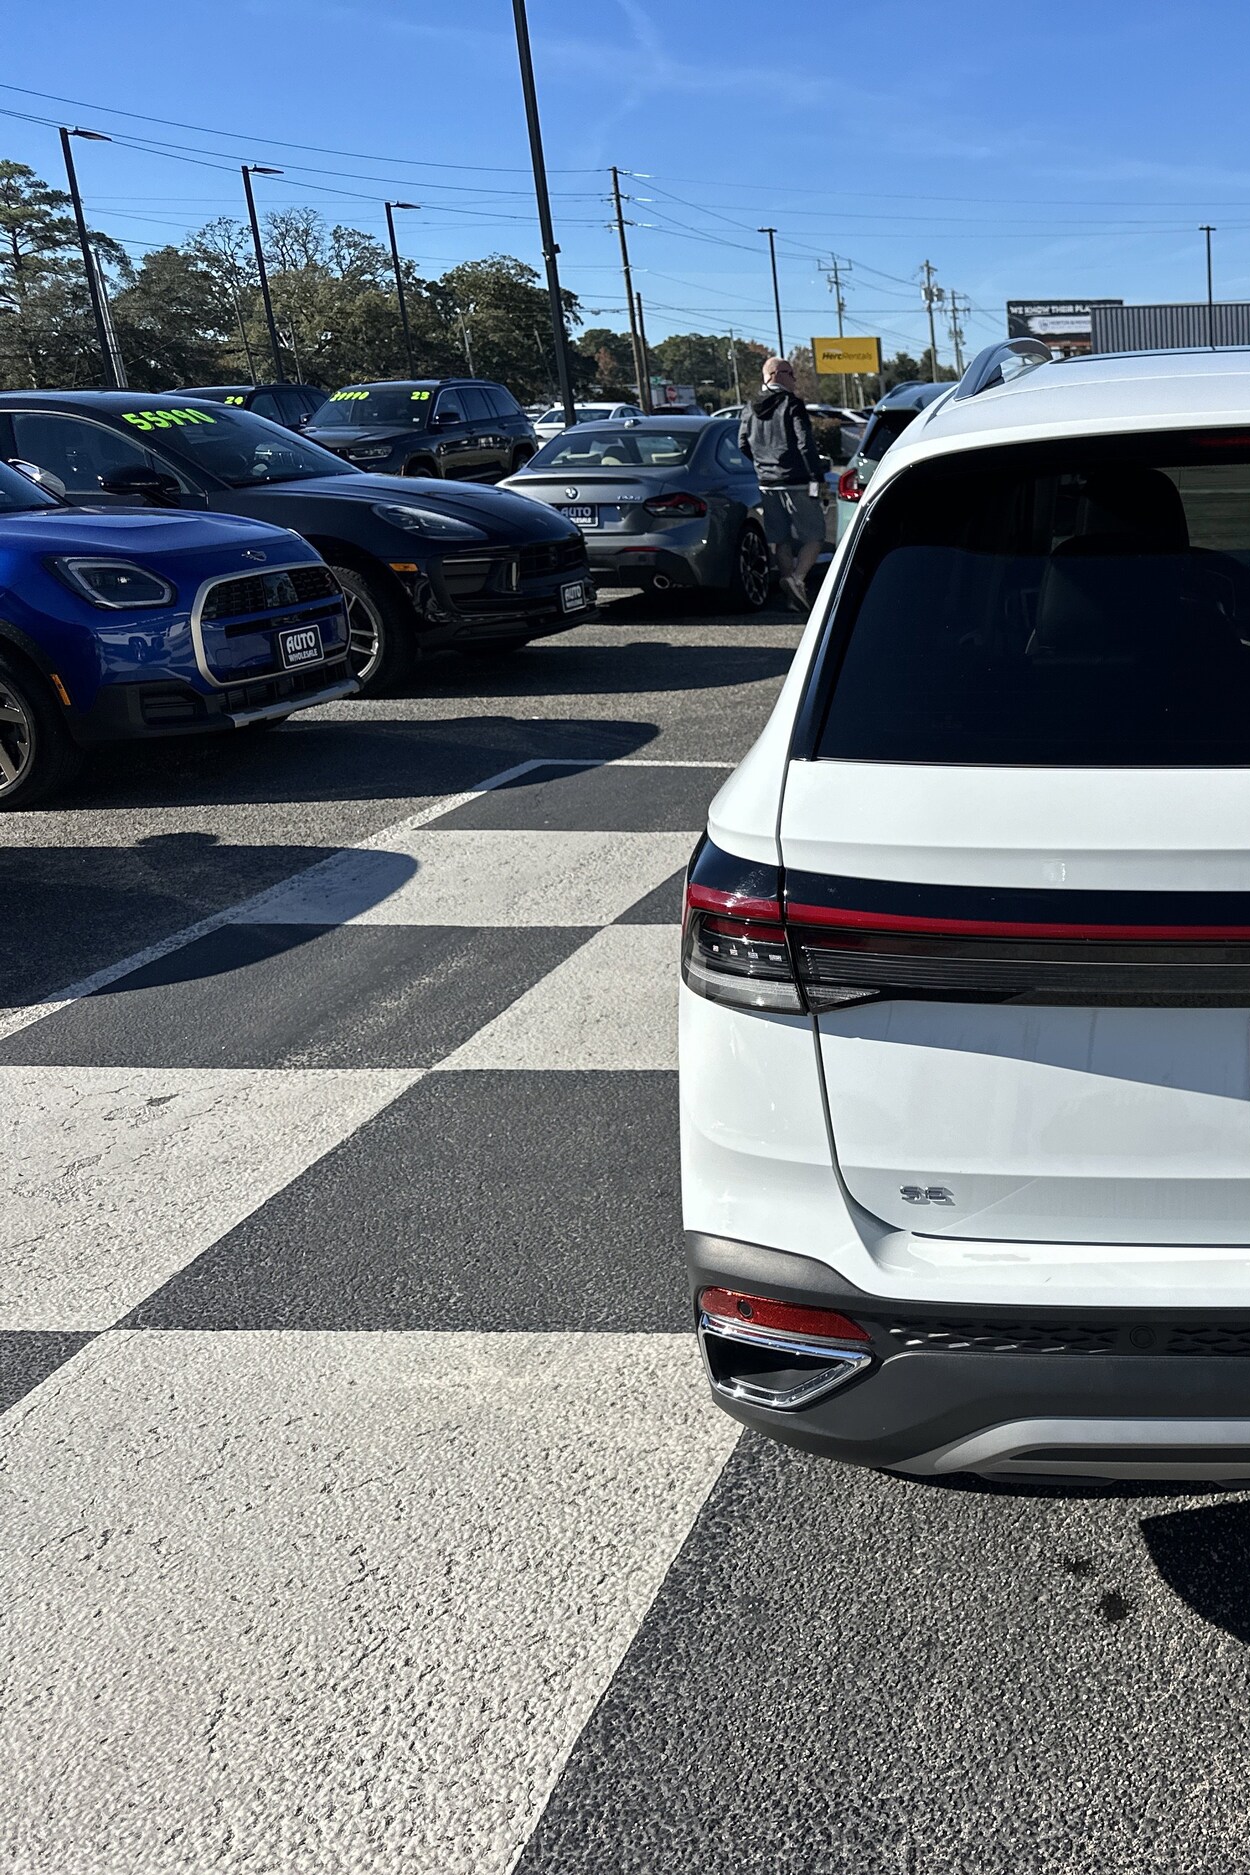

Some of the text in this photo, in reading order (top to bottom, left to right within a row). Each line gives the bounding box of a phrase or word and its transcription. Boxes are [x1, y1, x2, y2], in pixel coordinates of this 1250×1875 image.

[224, 396, 244, 405] 24
[121, 408, 217, 431] 55990
[560, 506, 592, 517] AUTO
[286, 631, 316, 654] AUTO
[900, 1186, 948, 1201] SE
